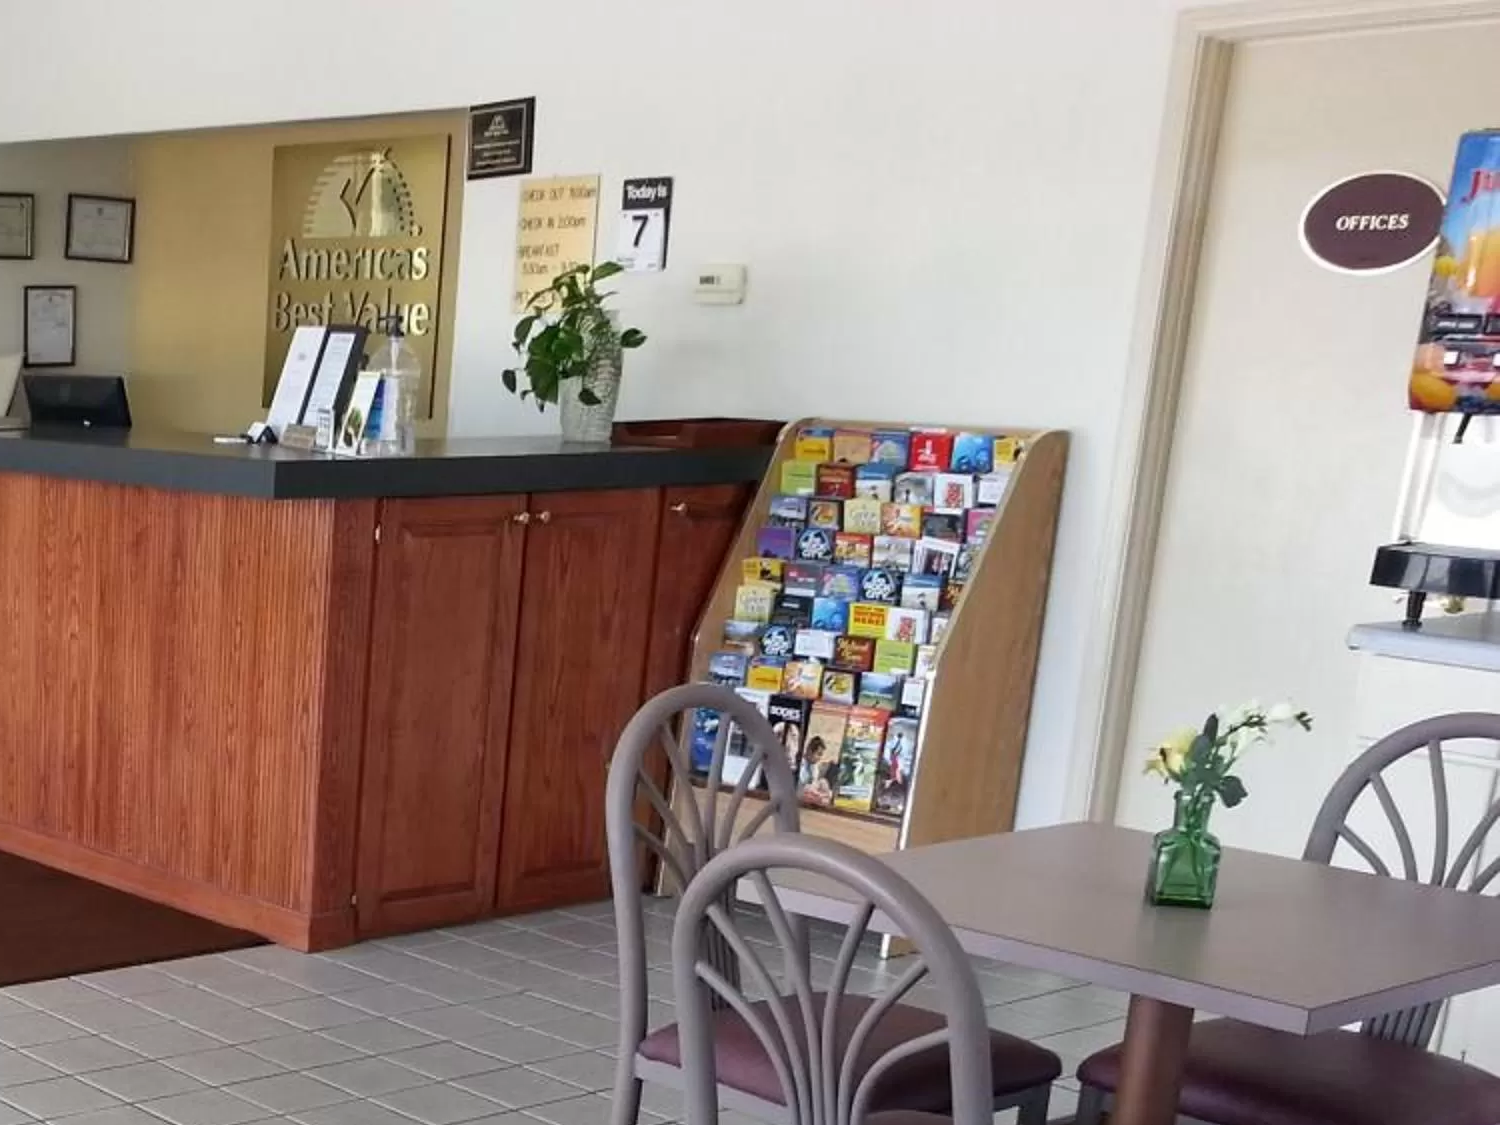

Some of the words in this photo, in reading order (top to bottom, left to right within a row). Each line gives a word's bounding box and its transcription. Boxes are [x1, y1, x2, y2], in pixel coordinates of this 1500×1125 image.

[627, 185, 657, 202] Today
[631, 214, 649, 248] 7
[1336, 214, 1409, 231] OFFICES
[279, 238, 430, 281] Americas
[275, 291, 336, 332] Best
[343, 287, 430, 336] Value
